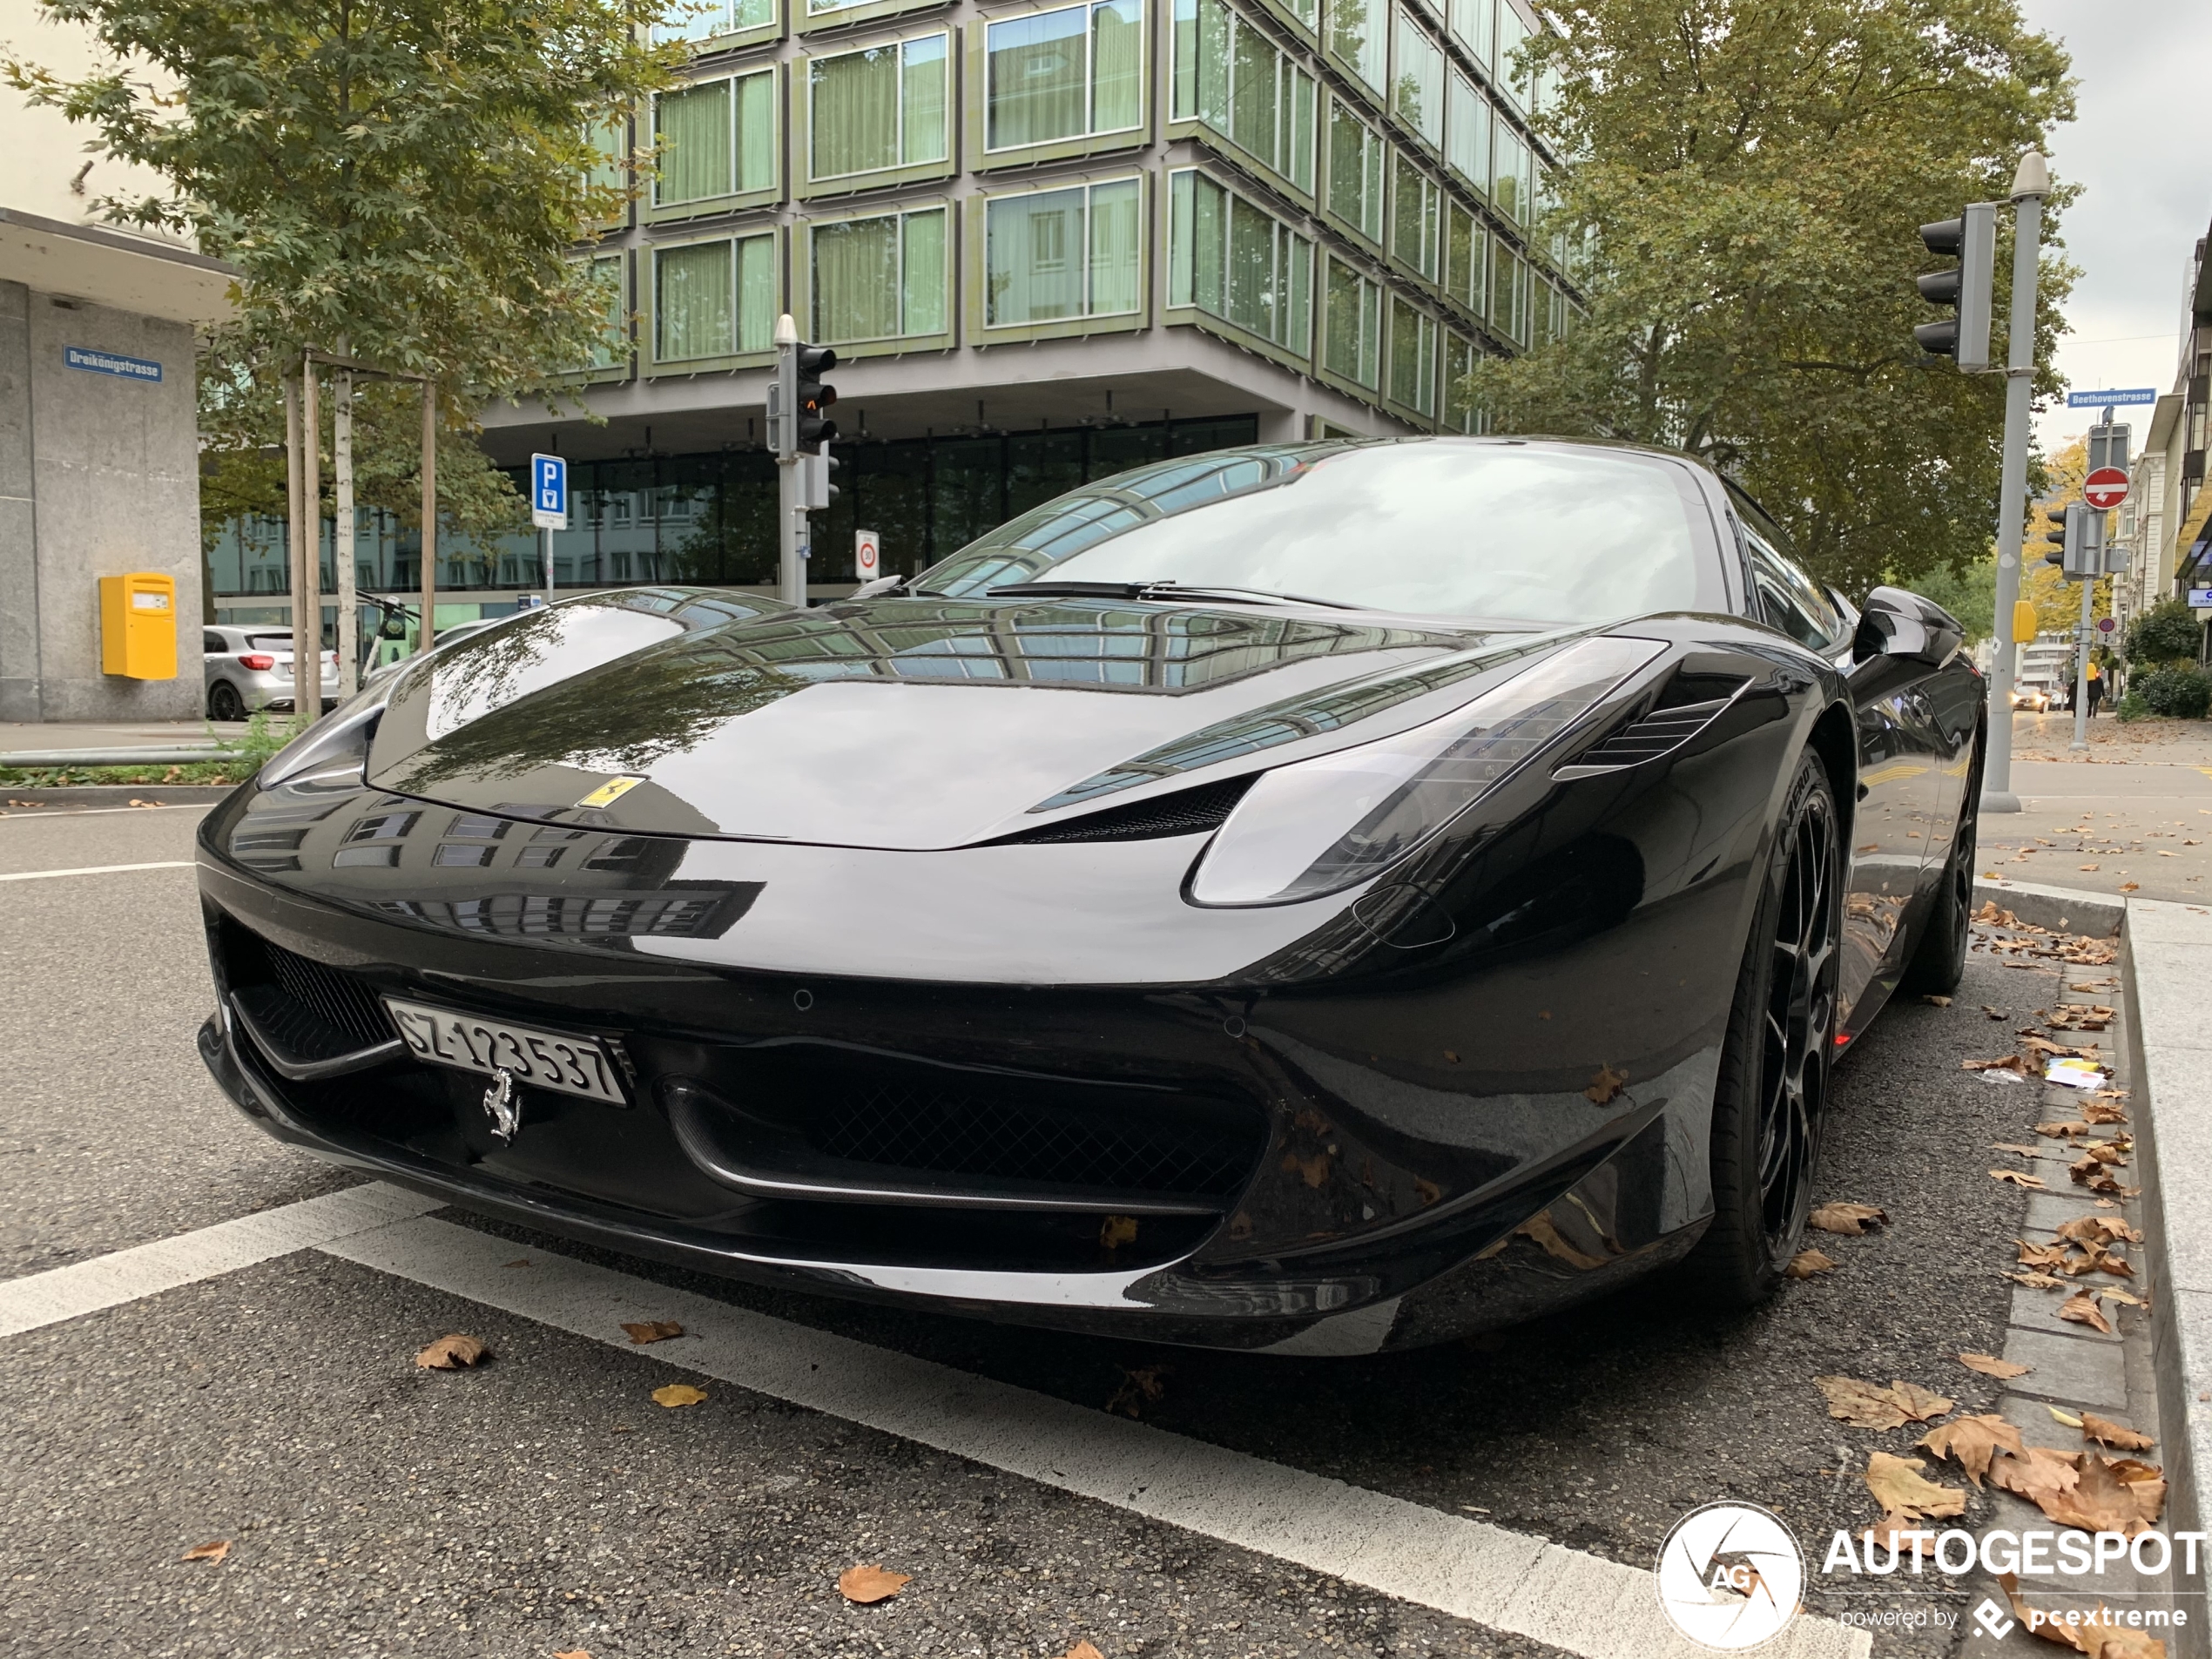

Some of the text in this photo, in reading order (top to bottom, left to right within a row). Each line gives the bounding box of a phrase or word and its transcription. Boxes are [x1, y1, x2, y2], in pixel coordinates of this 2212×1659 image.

[70, 350, 158, 376] Dreikönigstrasse
[2072, 393, 2151, 404] Beethovenstrasse
[543, 462, 557, 488] P
[865, 550, 872, 560] 30
